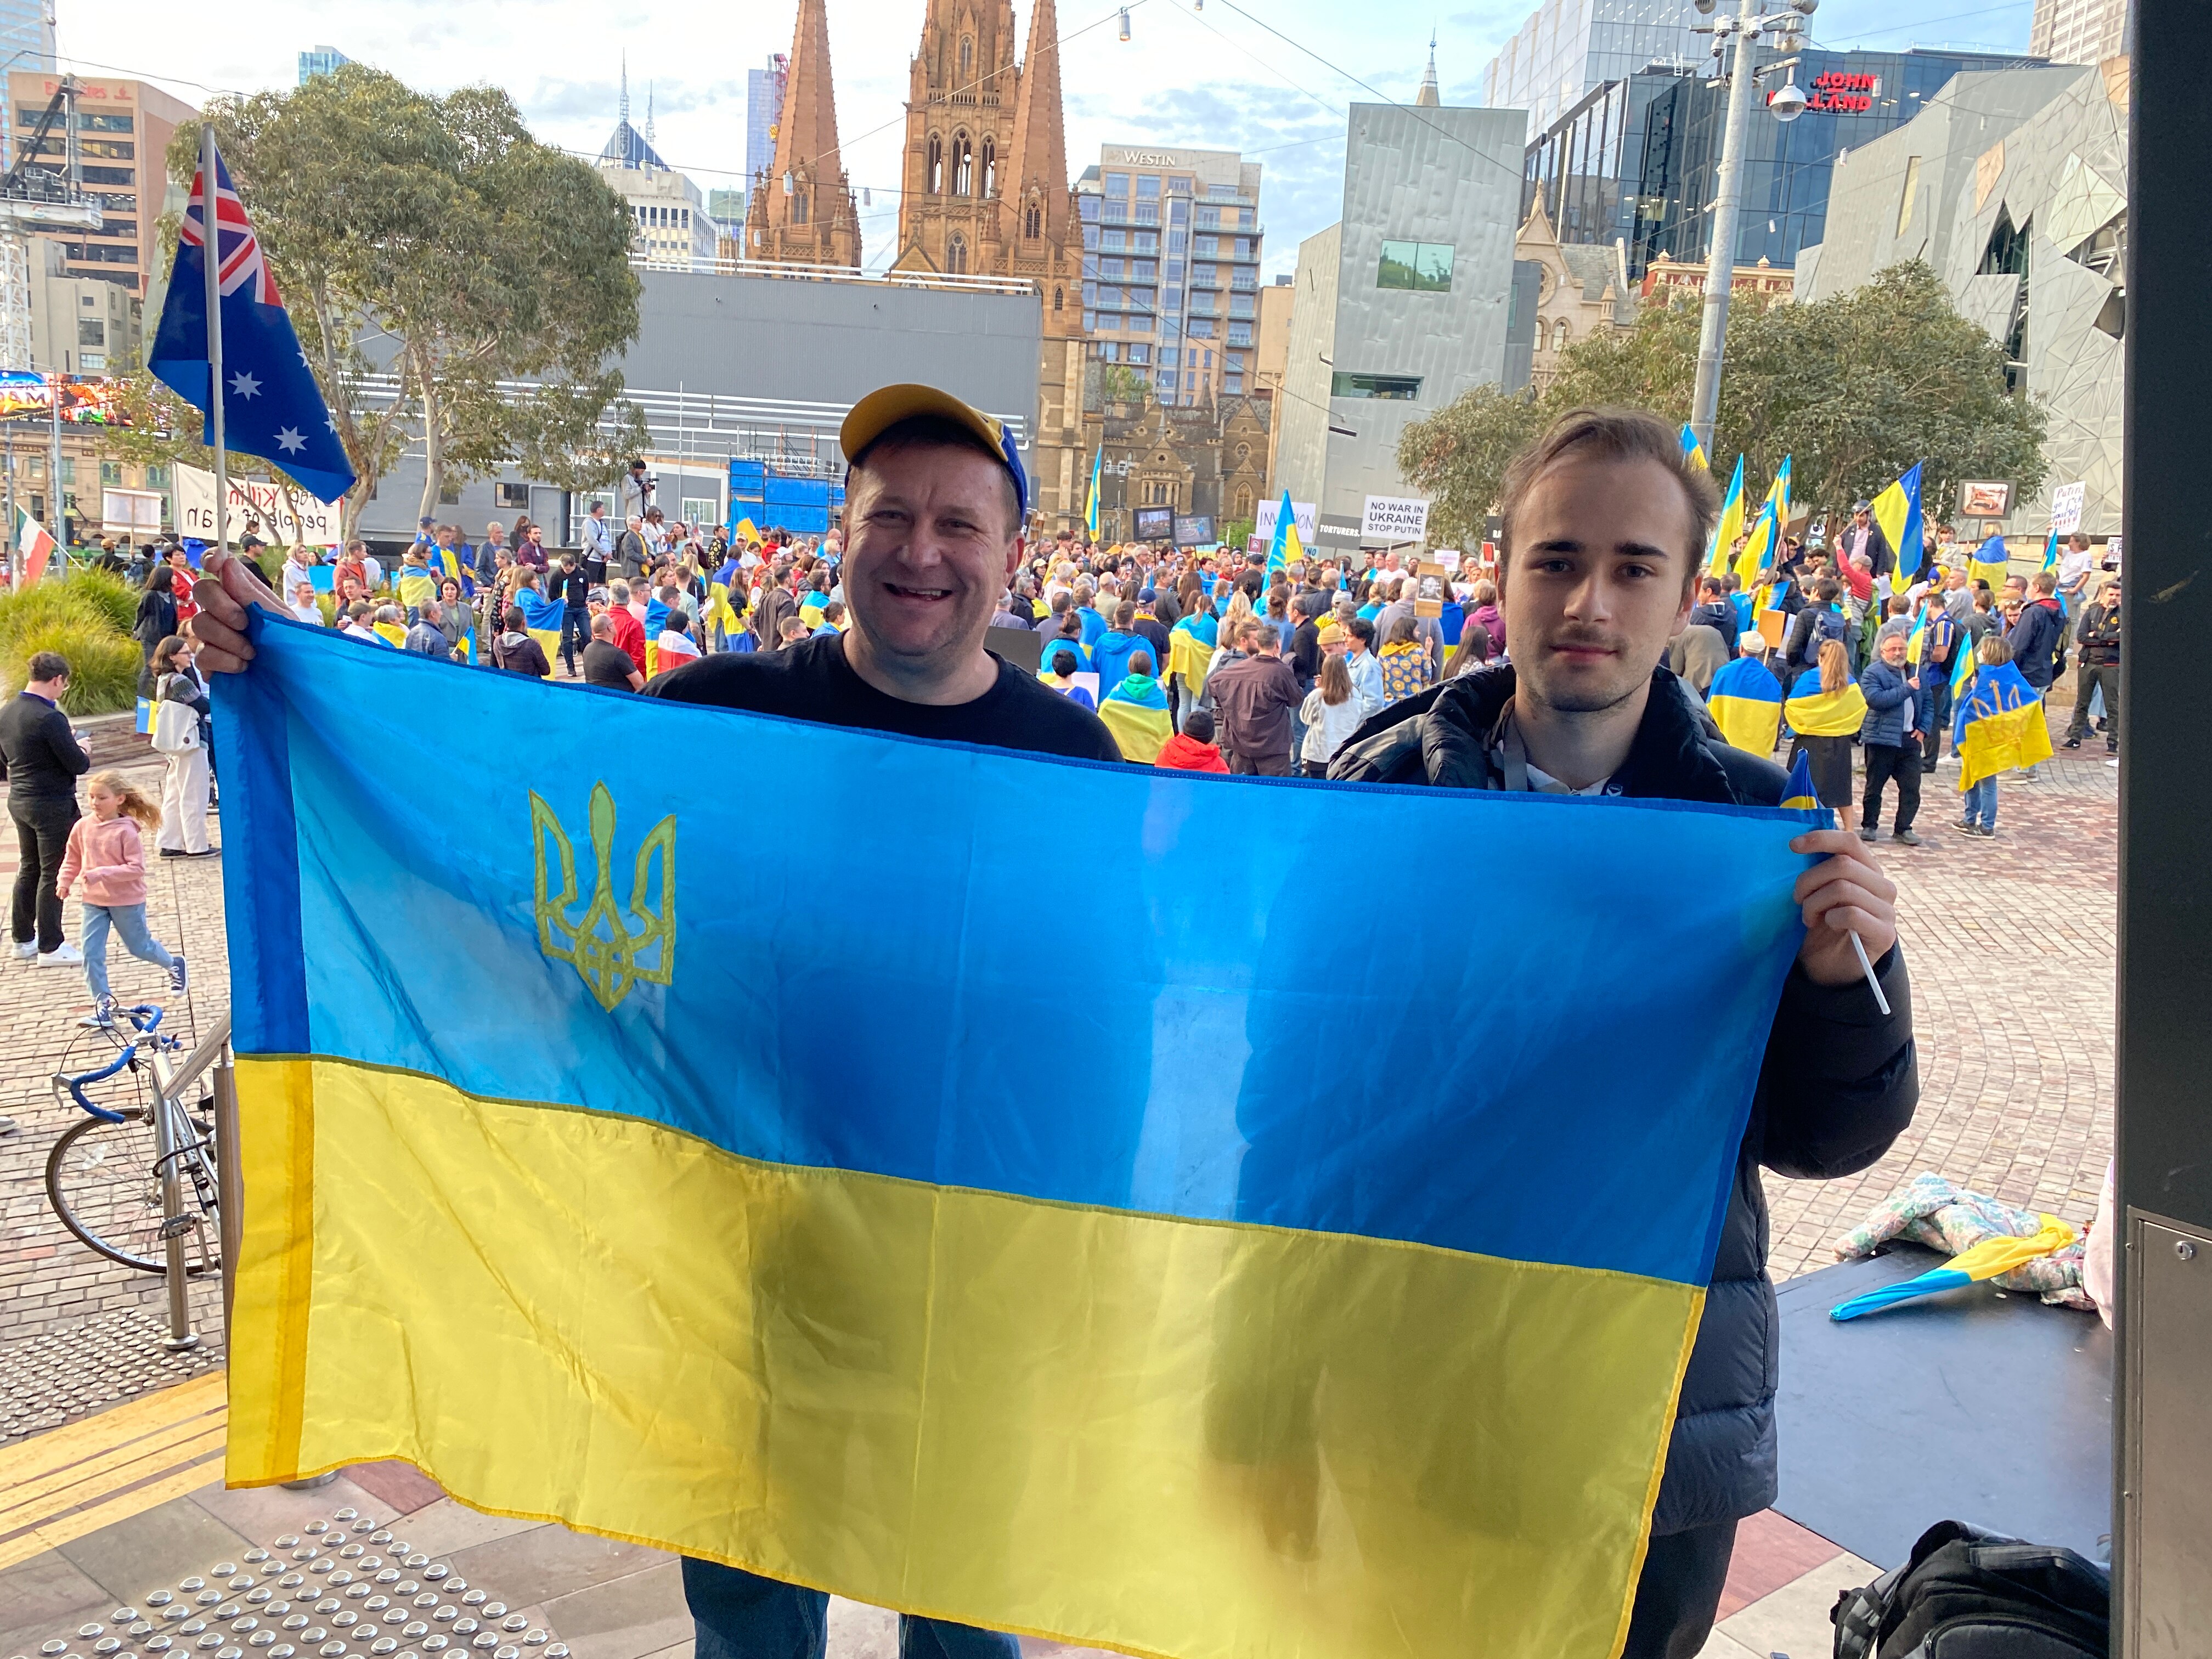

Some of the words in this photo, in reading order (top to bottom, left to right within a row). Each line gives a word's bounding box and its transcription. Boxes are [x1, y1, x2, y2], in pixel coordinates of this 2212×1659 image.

[1816, 71, 1876, 88] JOHN
[1124, 150, 1176, 166] WESTIN
[1371, 502, 1385, 510] NO
[1389, 504, 1411, 513] WAR
[1414, 505, 1424, 514] IN
[2052, 501, 2062, 513] go
[1260, 511, 1314, 530] INVION
[1369, 512, 1423, 525] UKRAINE
[1320, 524, 1360, 537] TORTURERS.
[1368, 523, 1392, 532] STOP
[1395, 526, 1421, 535] PUTIN
